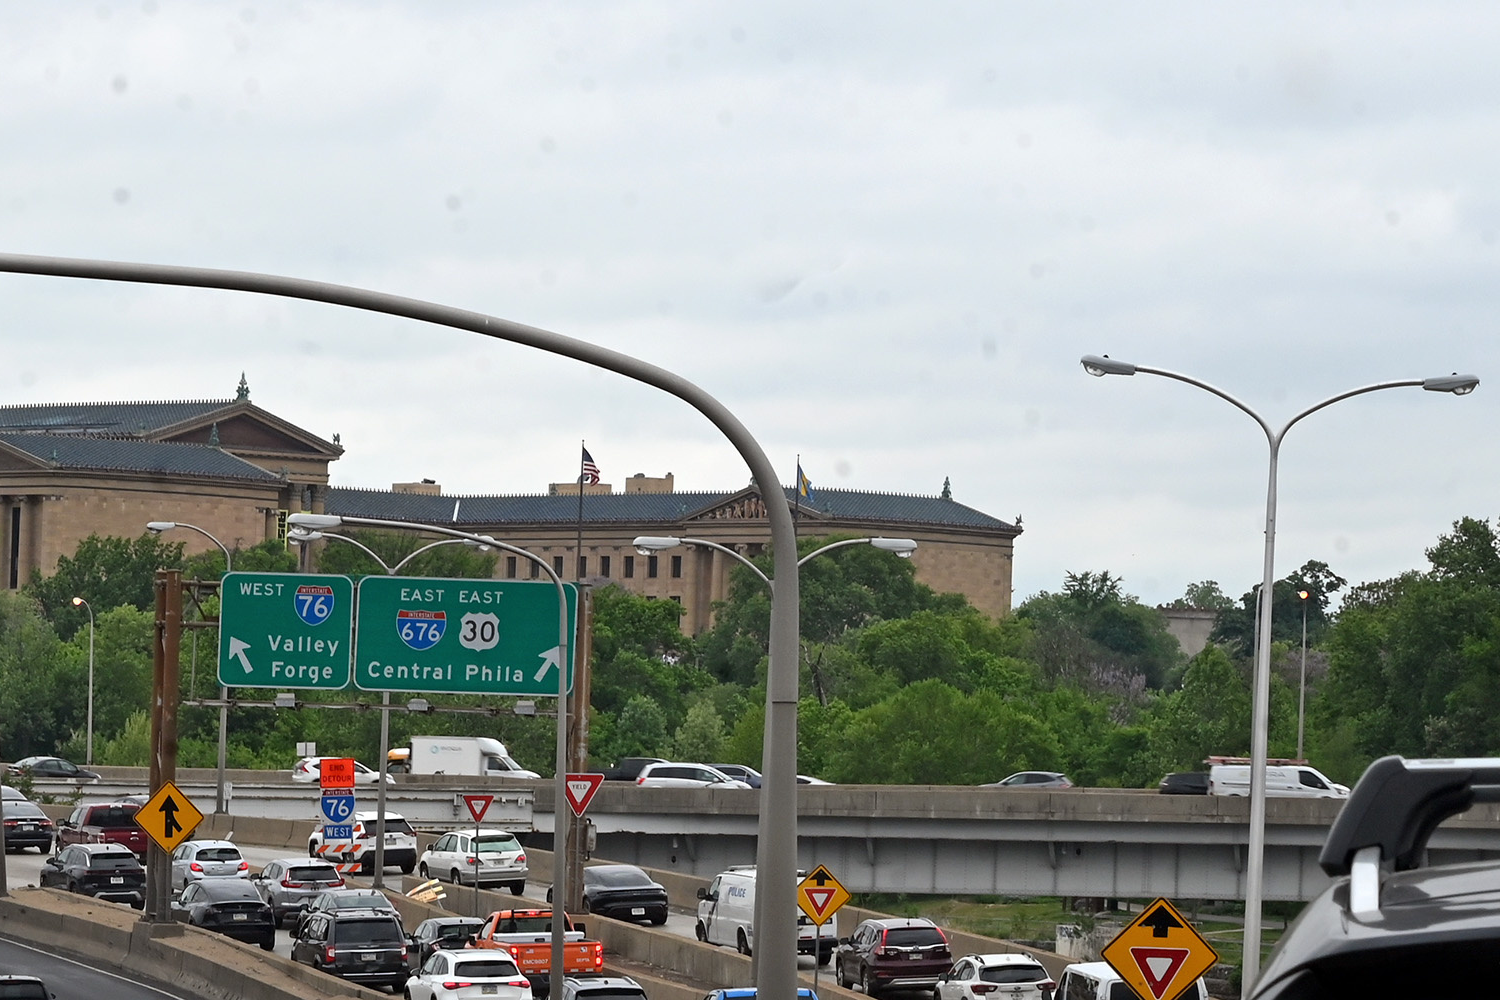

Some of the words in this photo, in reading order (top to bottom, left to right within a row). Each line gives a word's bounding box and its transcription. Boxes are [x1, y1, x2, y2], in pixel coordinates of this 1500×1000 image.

[240, 582, 284, 596] WEST
[400, 588, 445, 602] EAST
[459, 590, 504, 604] EAST
[298, 595, 328, 618] 76
[401, 622, 441, 642] 676
[463, 619, 495, 643] 30
[267, 634, 339, 657] Valley
[271, 661, 333, 684] Forge
[367, 661, 452, 680] Central
[465, 664, 524, 682] Phila
[329, 764, 345, 772] END
[322, 775, 352, 783] DETOUR
[326, 799, 350, 817] 76
[325, 826, 350, 838] WEST
[728, 887, 746, 898] POLICE
